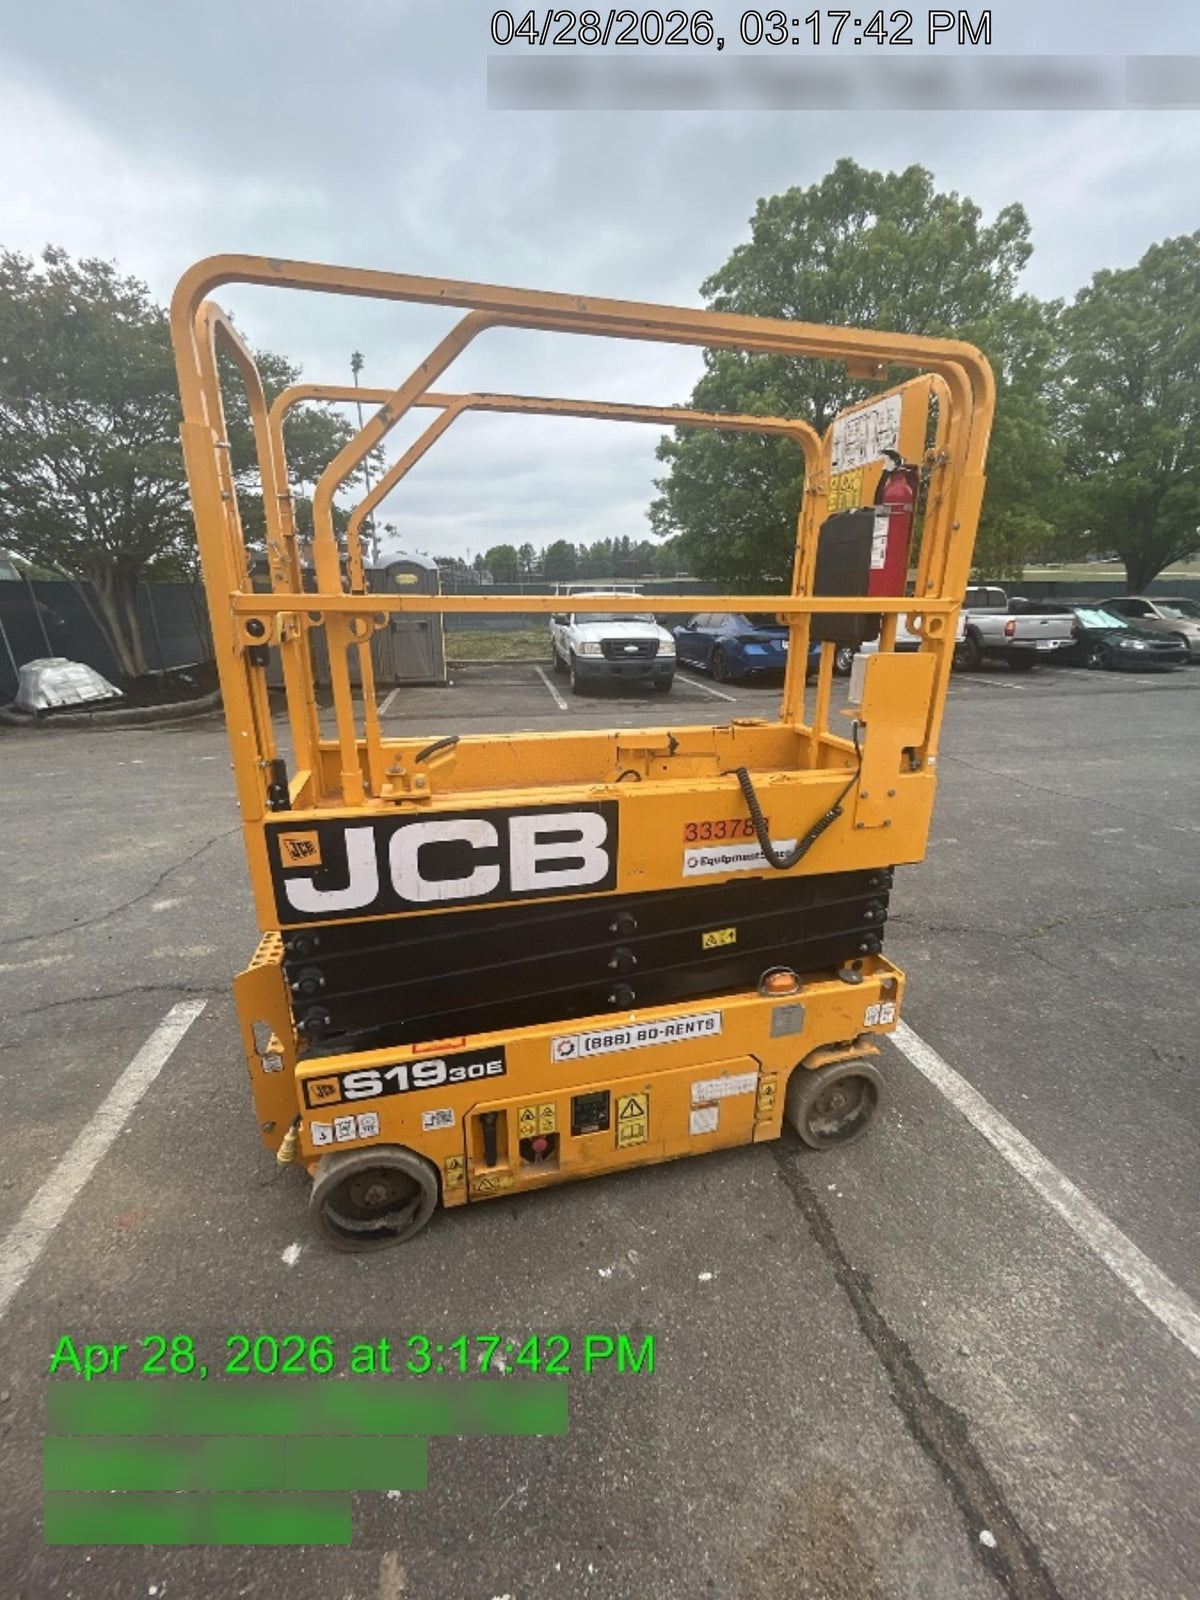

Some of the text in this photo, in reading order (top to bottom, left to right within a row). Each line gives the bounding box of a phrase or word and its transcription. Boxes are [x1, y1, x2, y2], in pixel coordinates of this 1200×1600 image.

[284, 812, 609, 912] JCB
[585, 1018, 715, 1050] (888) 80-RENTS
